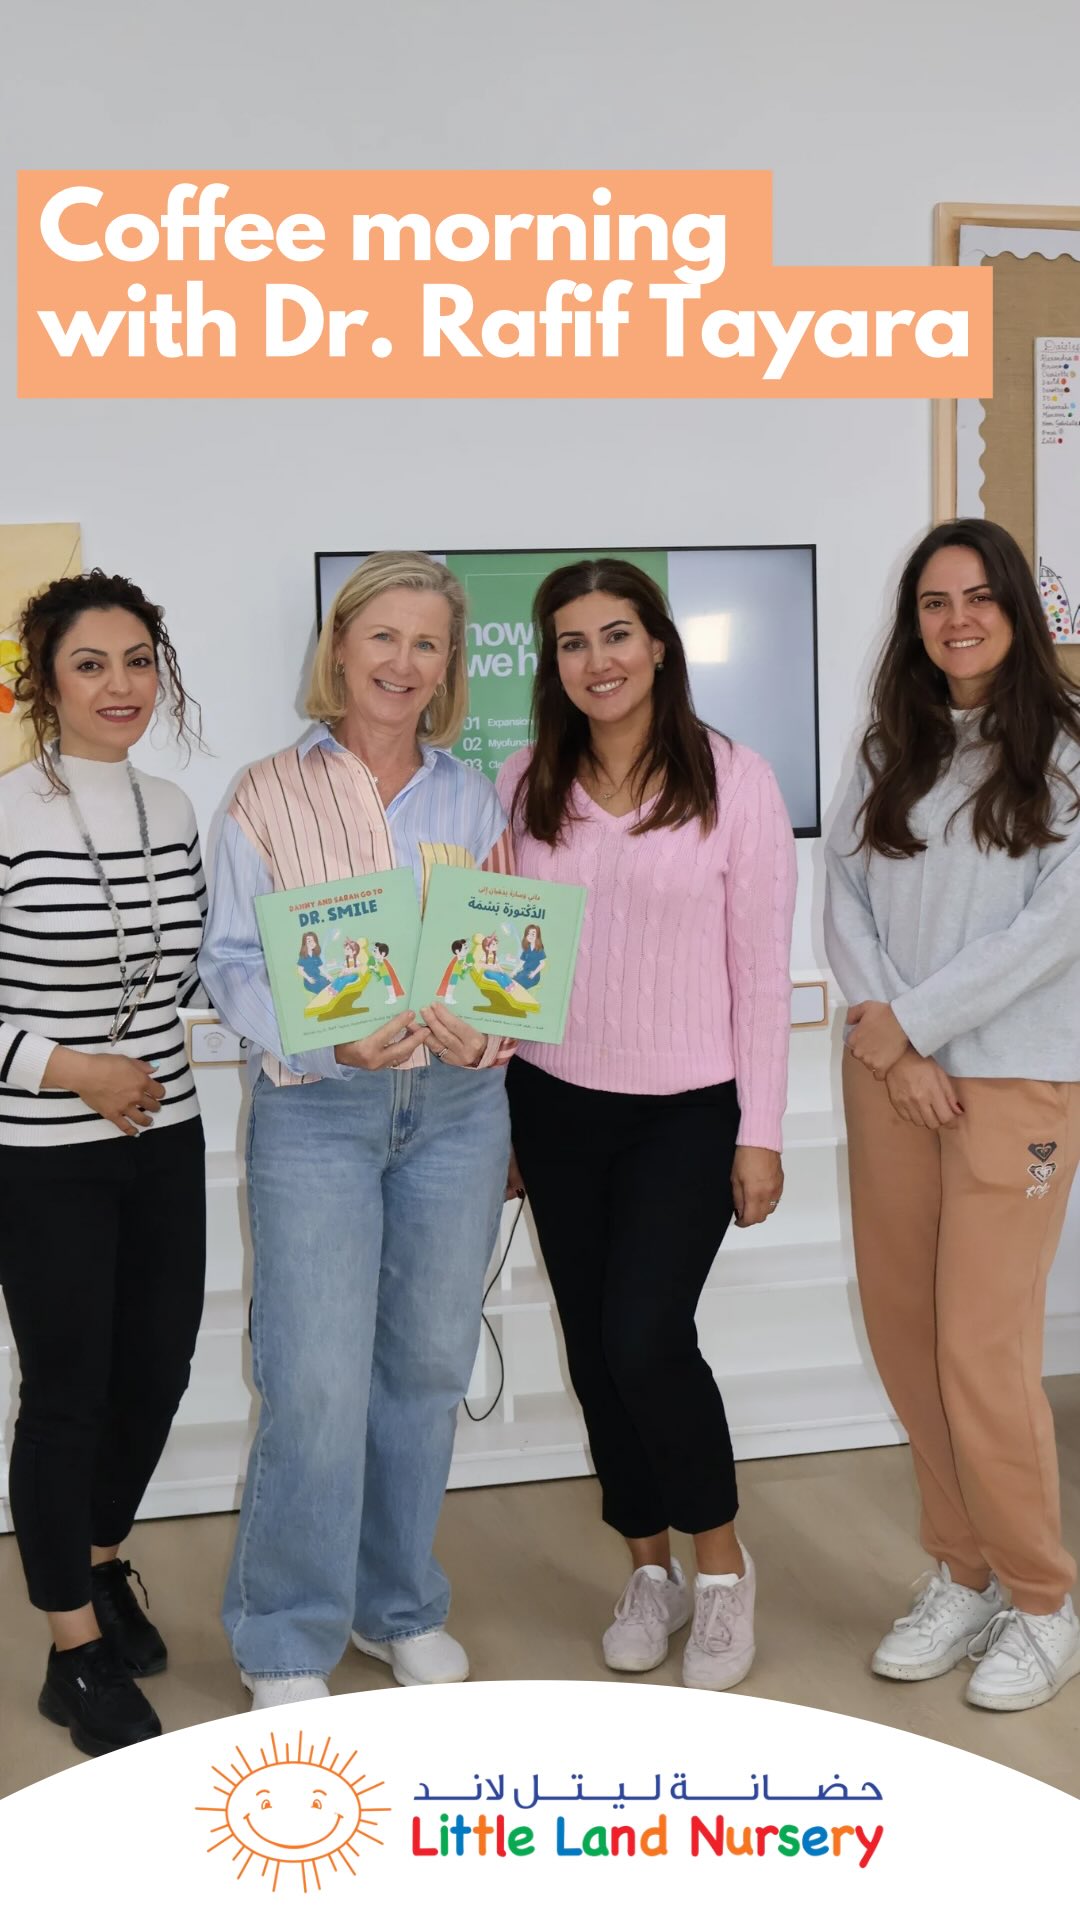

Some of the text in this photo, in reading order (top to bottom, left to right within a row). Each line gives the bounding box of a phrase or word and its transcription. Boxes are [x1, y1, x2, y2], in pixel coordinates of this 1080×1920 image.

[467, 652, 513, 678] we
[462, 736, 483, 751] 02
[288, 888, 384, 912] DANNY AND SARAH GO TO
[298, 899, 378, 927] DR. SMILE
